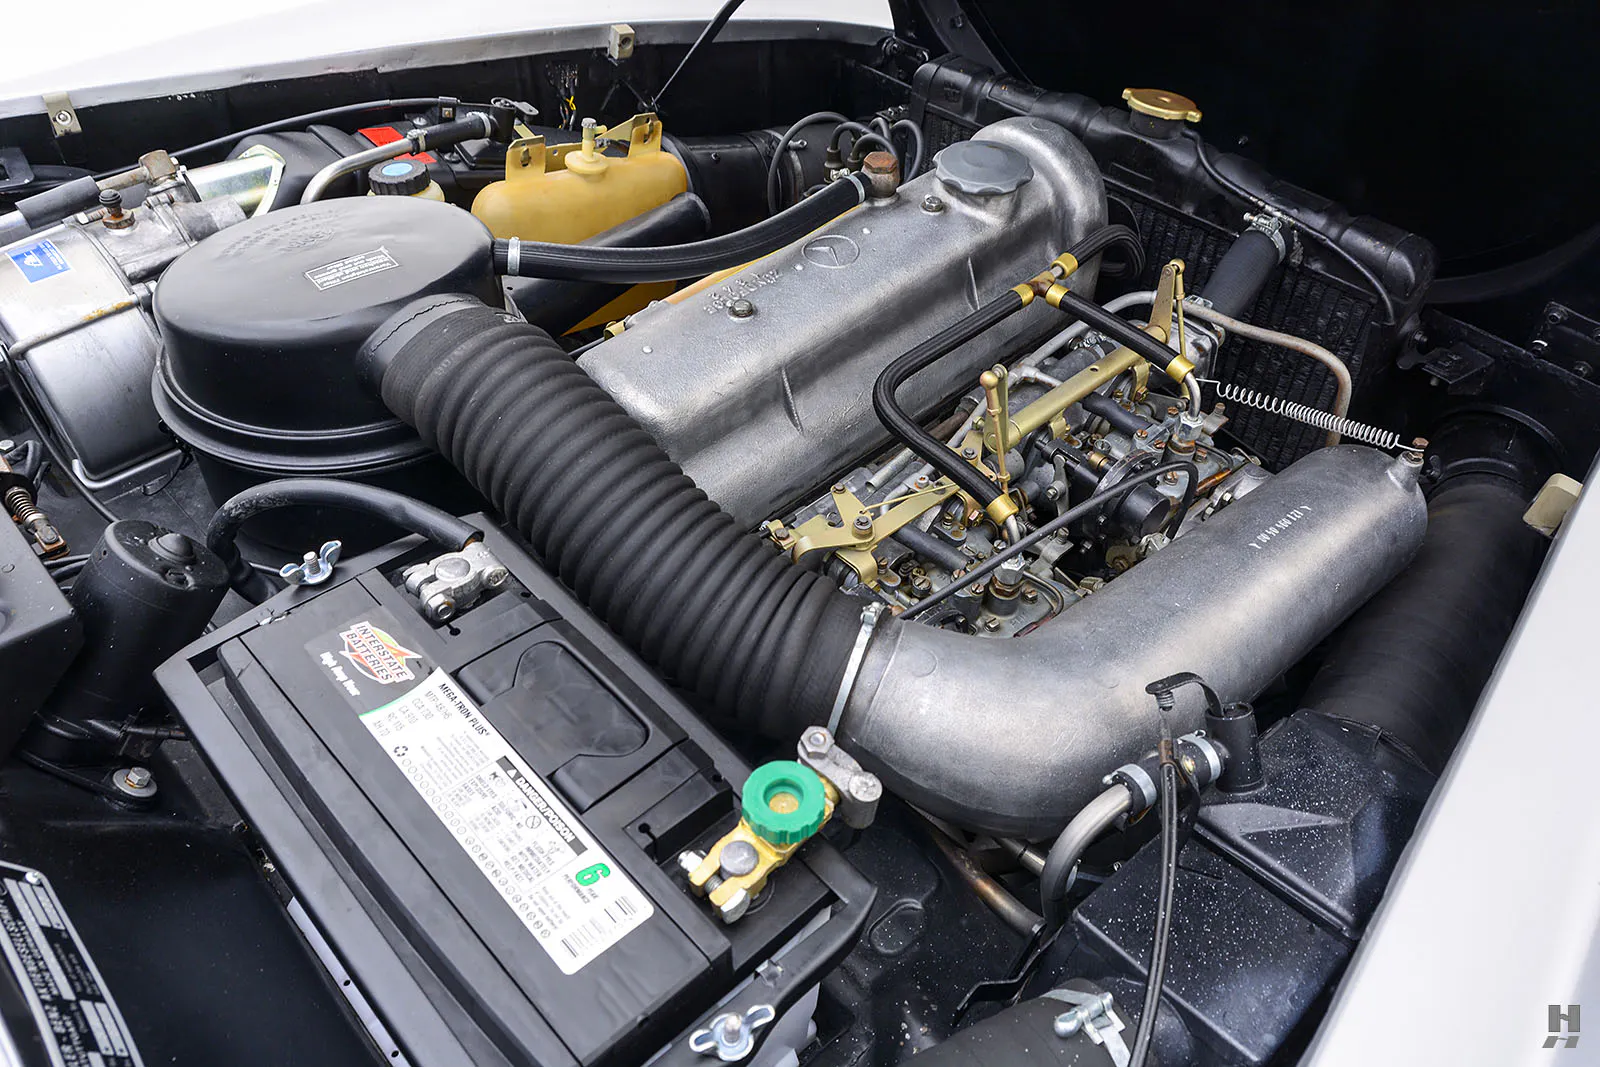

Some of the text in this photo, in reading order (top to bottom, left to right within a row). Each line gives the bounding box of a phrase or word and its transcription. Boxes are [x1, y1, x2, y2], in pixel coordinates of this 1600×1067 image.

[345, 632, 392, 681] BATTERIES
[357, 624, 407, 678] INTERSTATE
[438, 683, 472, 718] MEGA-TRON
[514, 777, 575, 842] DANGER/POISON
[574, 863, 610, 887] 6
